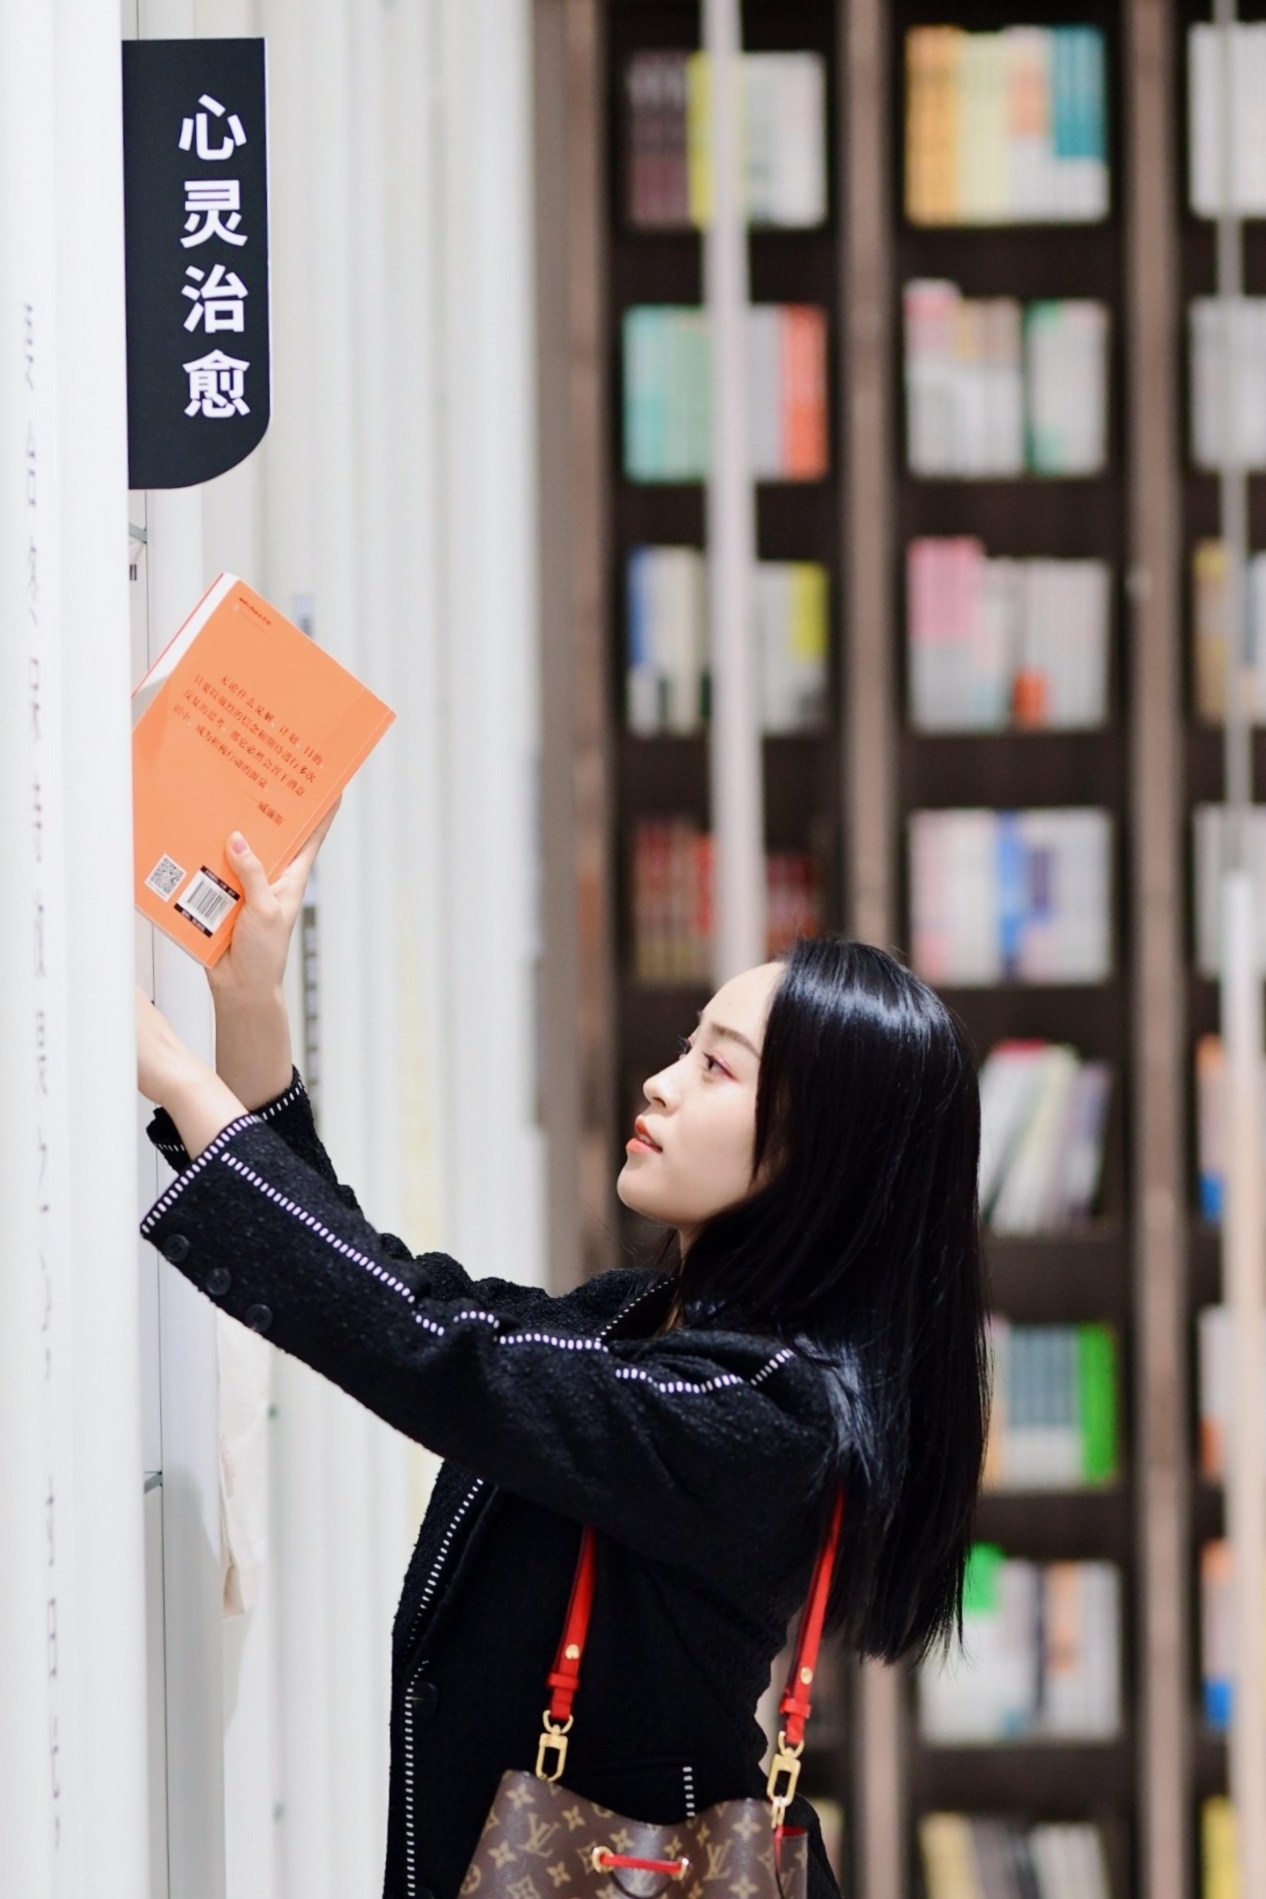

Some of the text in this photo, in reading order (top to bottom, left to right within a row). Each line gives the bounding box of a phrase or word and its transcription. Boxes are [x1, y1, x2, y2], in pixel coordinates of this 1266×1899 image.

[178, 94, 250, 418] 心灵治愈
[514, 1812, 561, 1858] LV
[701, 1839, 734, 1881] LV
